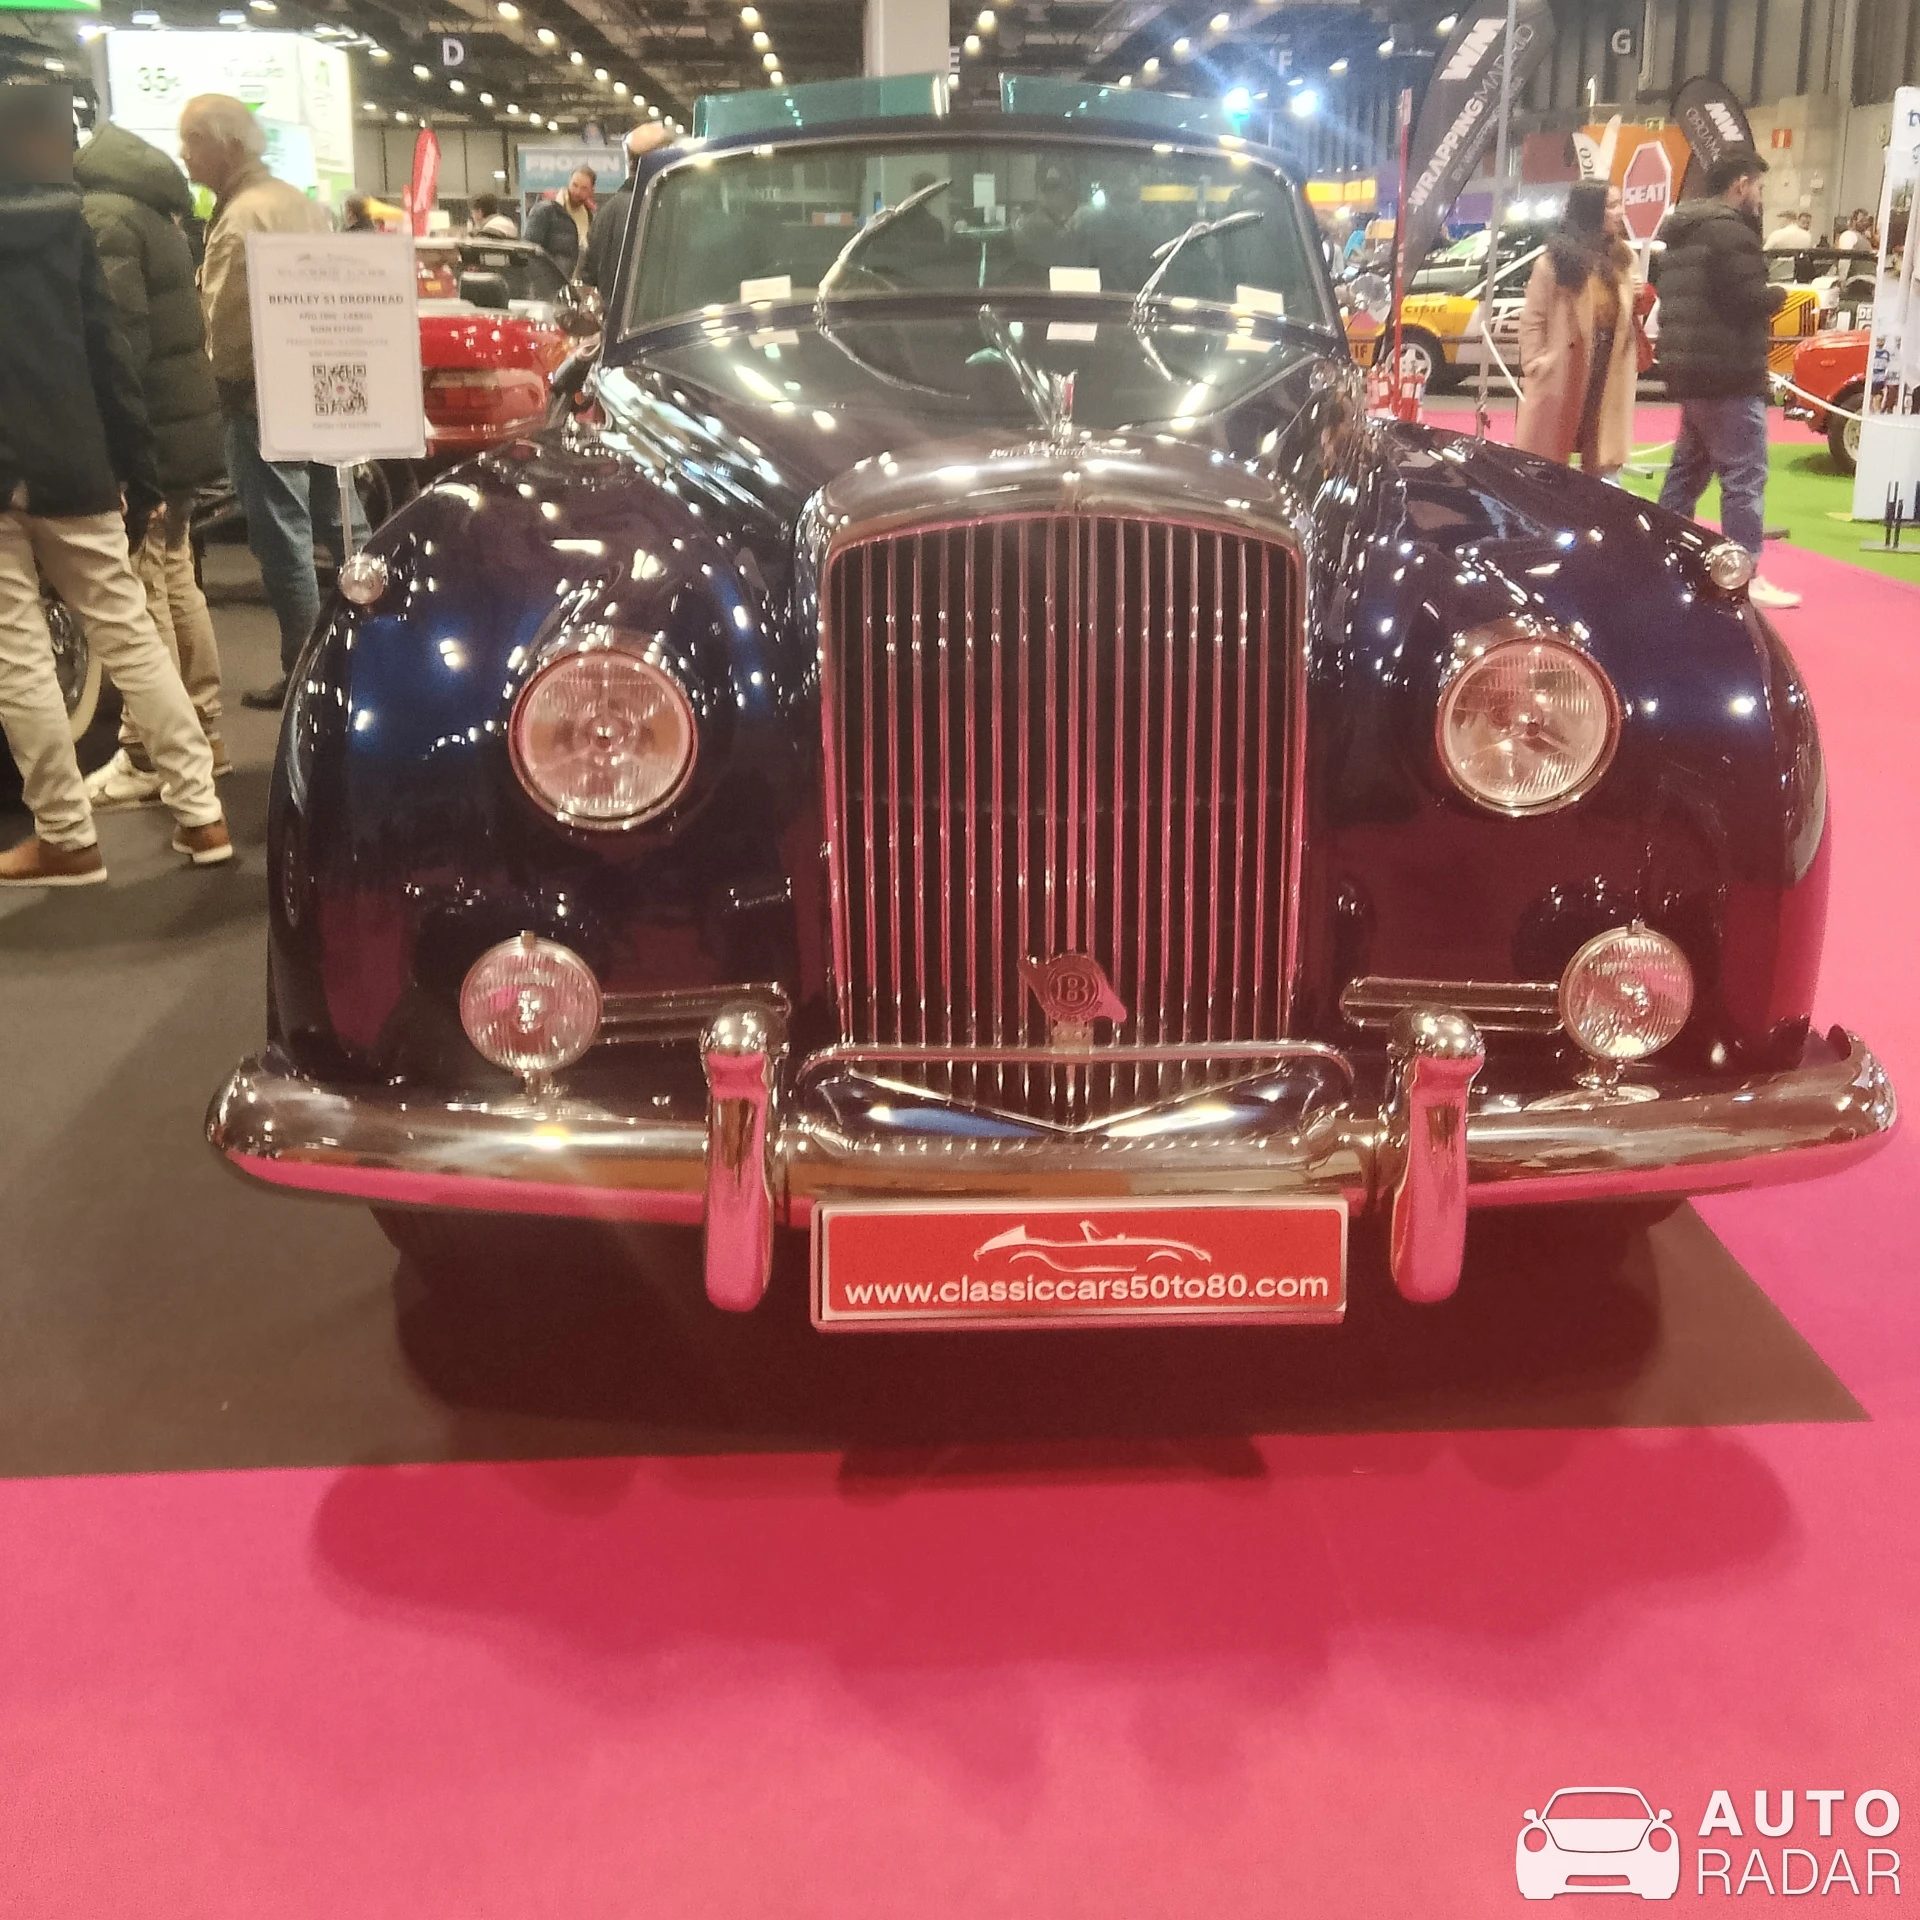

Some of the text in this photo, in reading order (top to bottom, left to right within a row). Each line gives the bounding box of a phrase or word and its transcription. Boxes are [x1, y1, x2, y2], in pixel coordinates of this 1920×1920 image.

[442, 38, 465, 66] D
[1611, 28, 1631, 54] G
[1625, 184, 1666, 206] SEAT
[268, 294, 319, 305] BENTLEY
[340, 295, 404, 305] DROPHEAD
[1057, 972, 1089, 1005] B
[844, 1273, 1330, 1305] www.classiccars50to80.com
